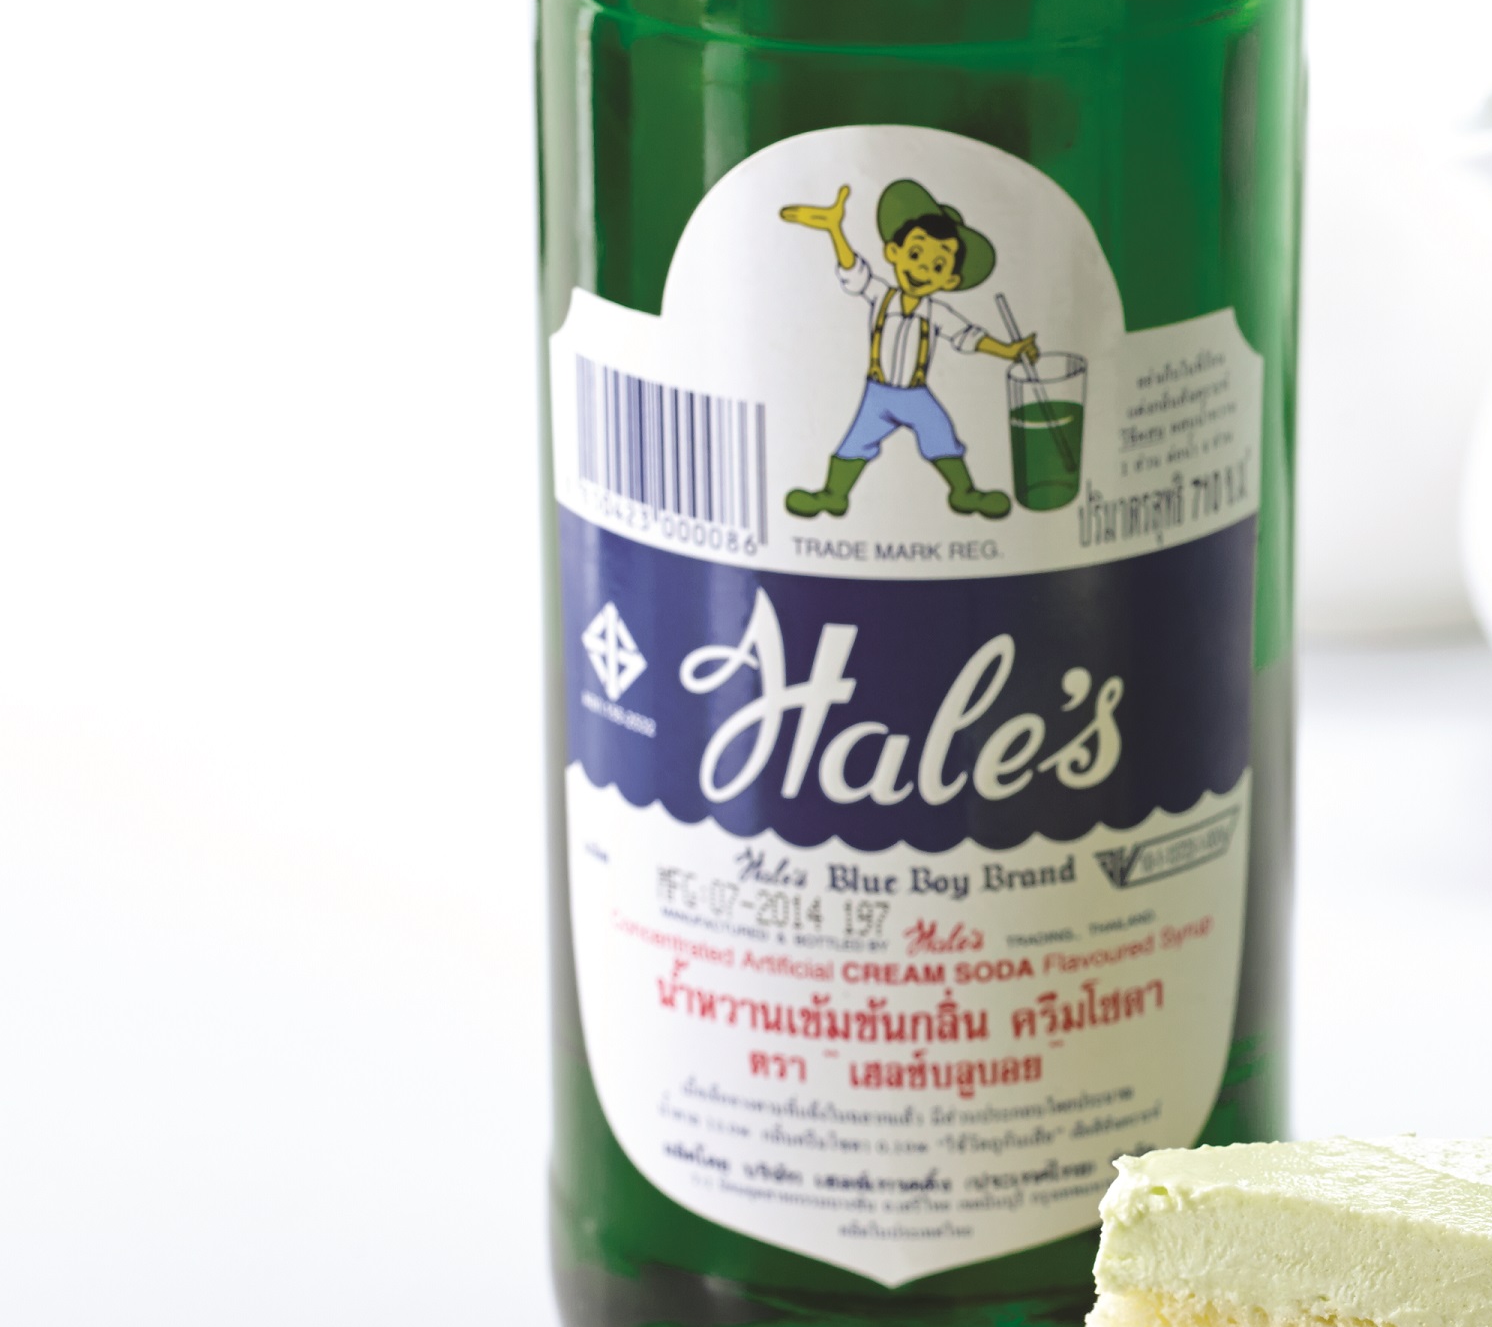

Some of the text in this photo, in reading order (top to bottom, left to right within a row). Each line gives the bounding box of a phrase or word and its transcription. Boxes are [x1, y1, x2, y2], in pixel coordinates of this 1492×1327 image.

[660, 513, 759, 557] 000086
[791, 535, 1004, 563] TRADE MARK REG.
[679, 587, 1124, 806] Hale's
[825, 864, 899, 897] Blue
[909, 865, 971, 900] Boy
[981, 854, 1077, 895] Brand
[841, 897, 891, 940] 197
[611, 907, 735, 969] Concentrated
[741, 949, 835, 983] Artificial
[841, 962, 946, 987] CREAM
[952, 958, 1036, 986] SODA
[1042, 932, 1157, 977] Flavoured
[749, 1048, 810, 1085] ตรา
